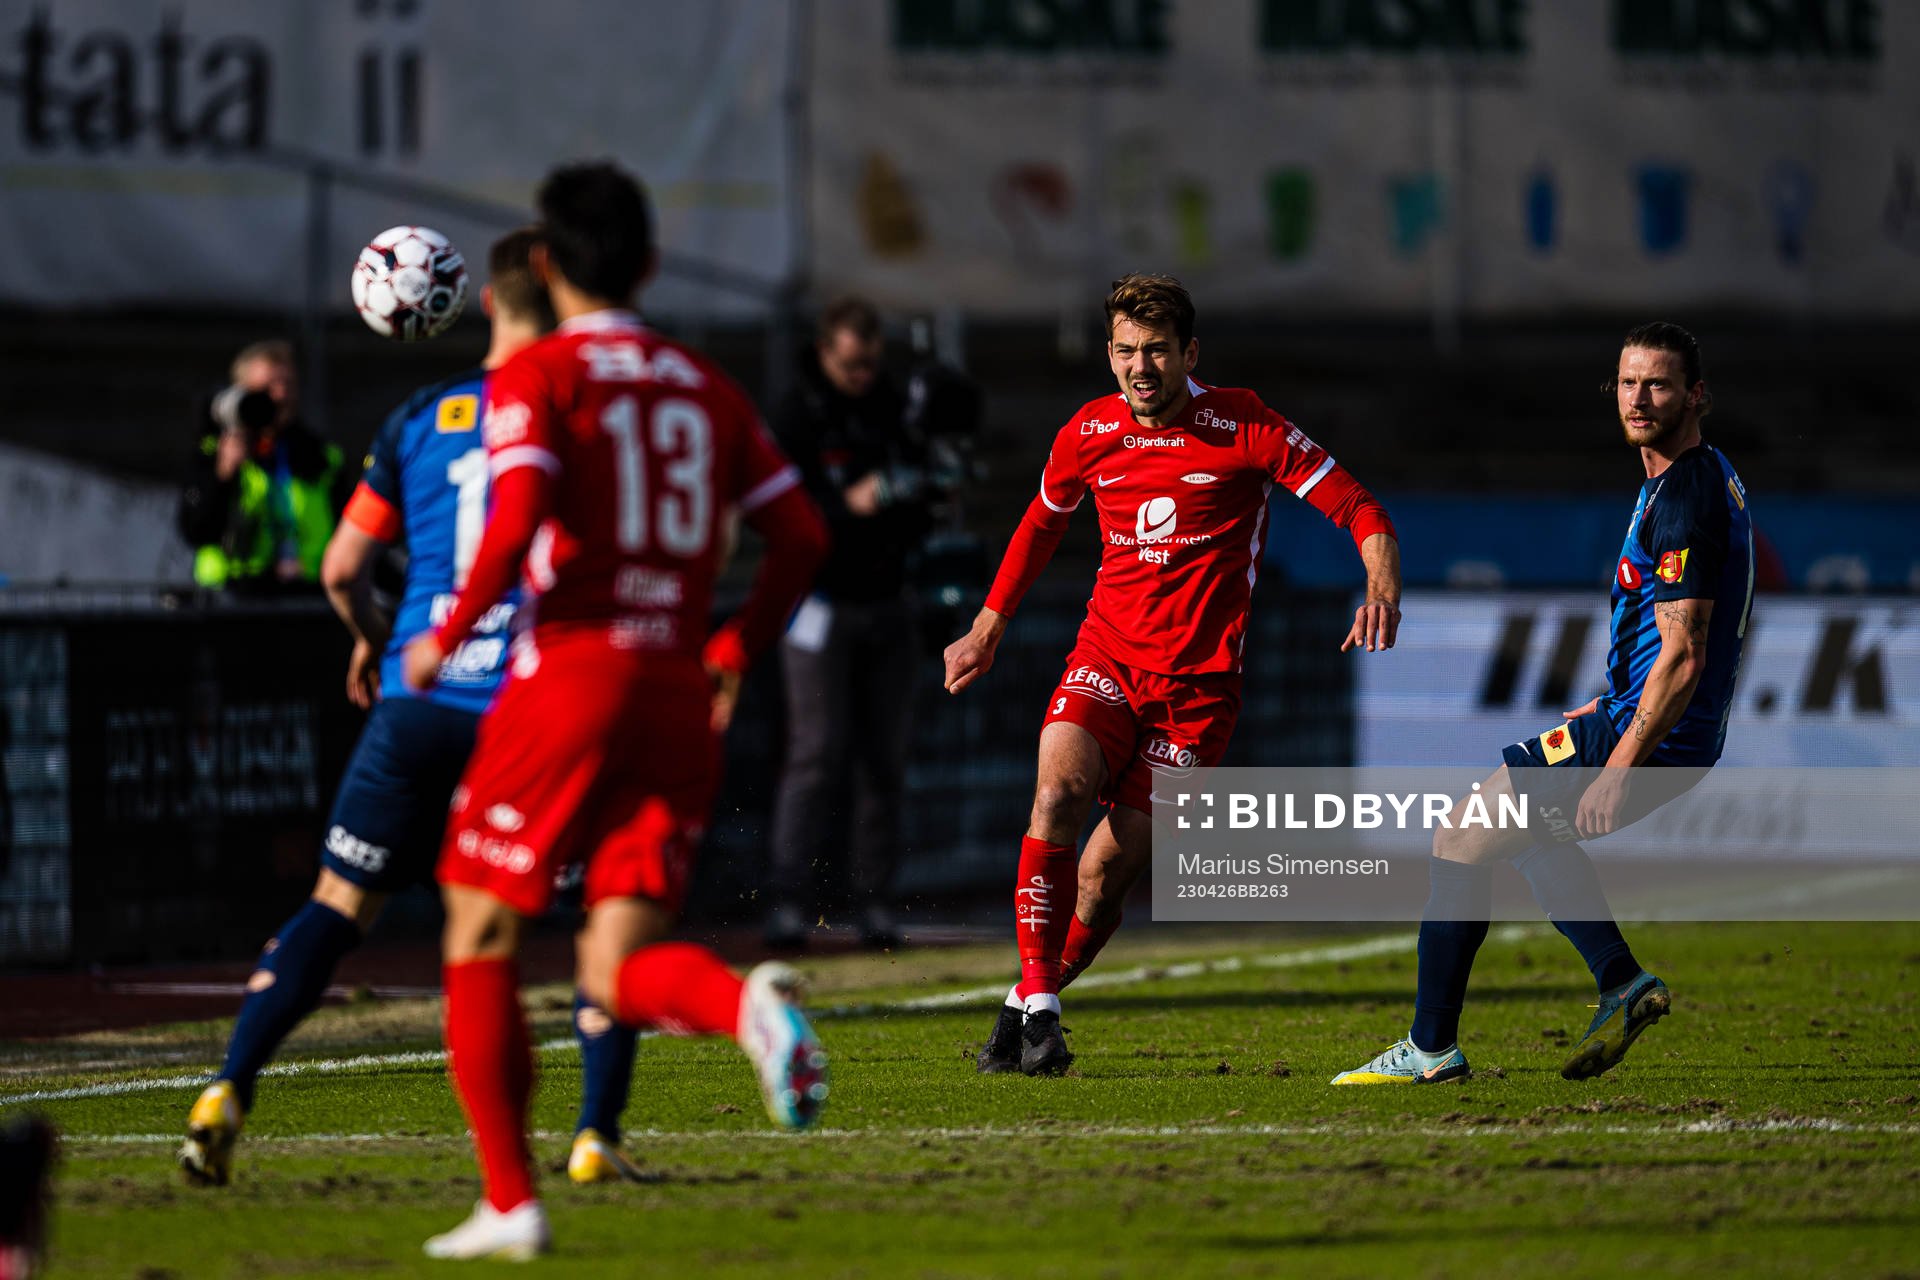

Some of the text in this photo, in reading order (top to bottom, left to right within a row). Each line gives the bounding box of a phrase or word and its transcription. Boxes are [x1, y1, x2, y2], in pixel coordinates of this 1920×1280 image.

[21, 4, 272, 154] tata
[1097, 419, 1120, 435] BOB
[1211, 416, 1237, 432] BOB
[1136, 435, 1185, 448] Fjordkraft
[599, 393, 715, 559] 13
[1188, 475, 1210, 483] BRANN
[1138, 546, 1170, 565] Vest
[1621, 562, 1633, 584] 1
[1065, 667, 1126, 699] LERØY
[1052, 697, 1067, 715] 3
[1147, 738, 1201, 769] LERØY
